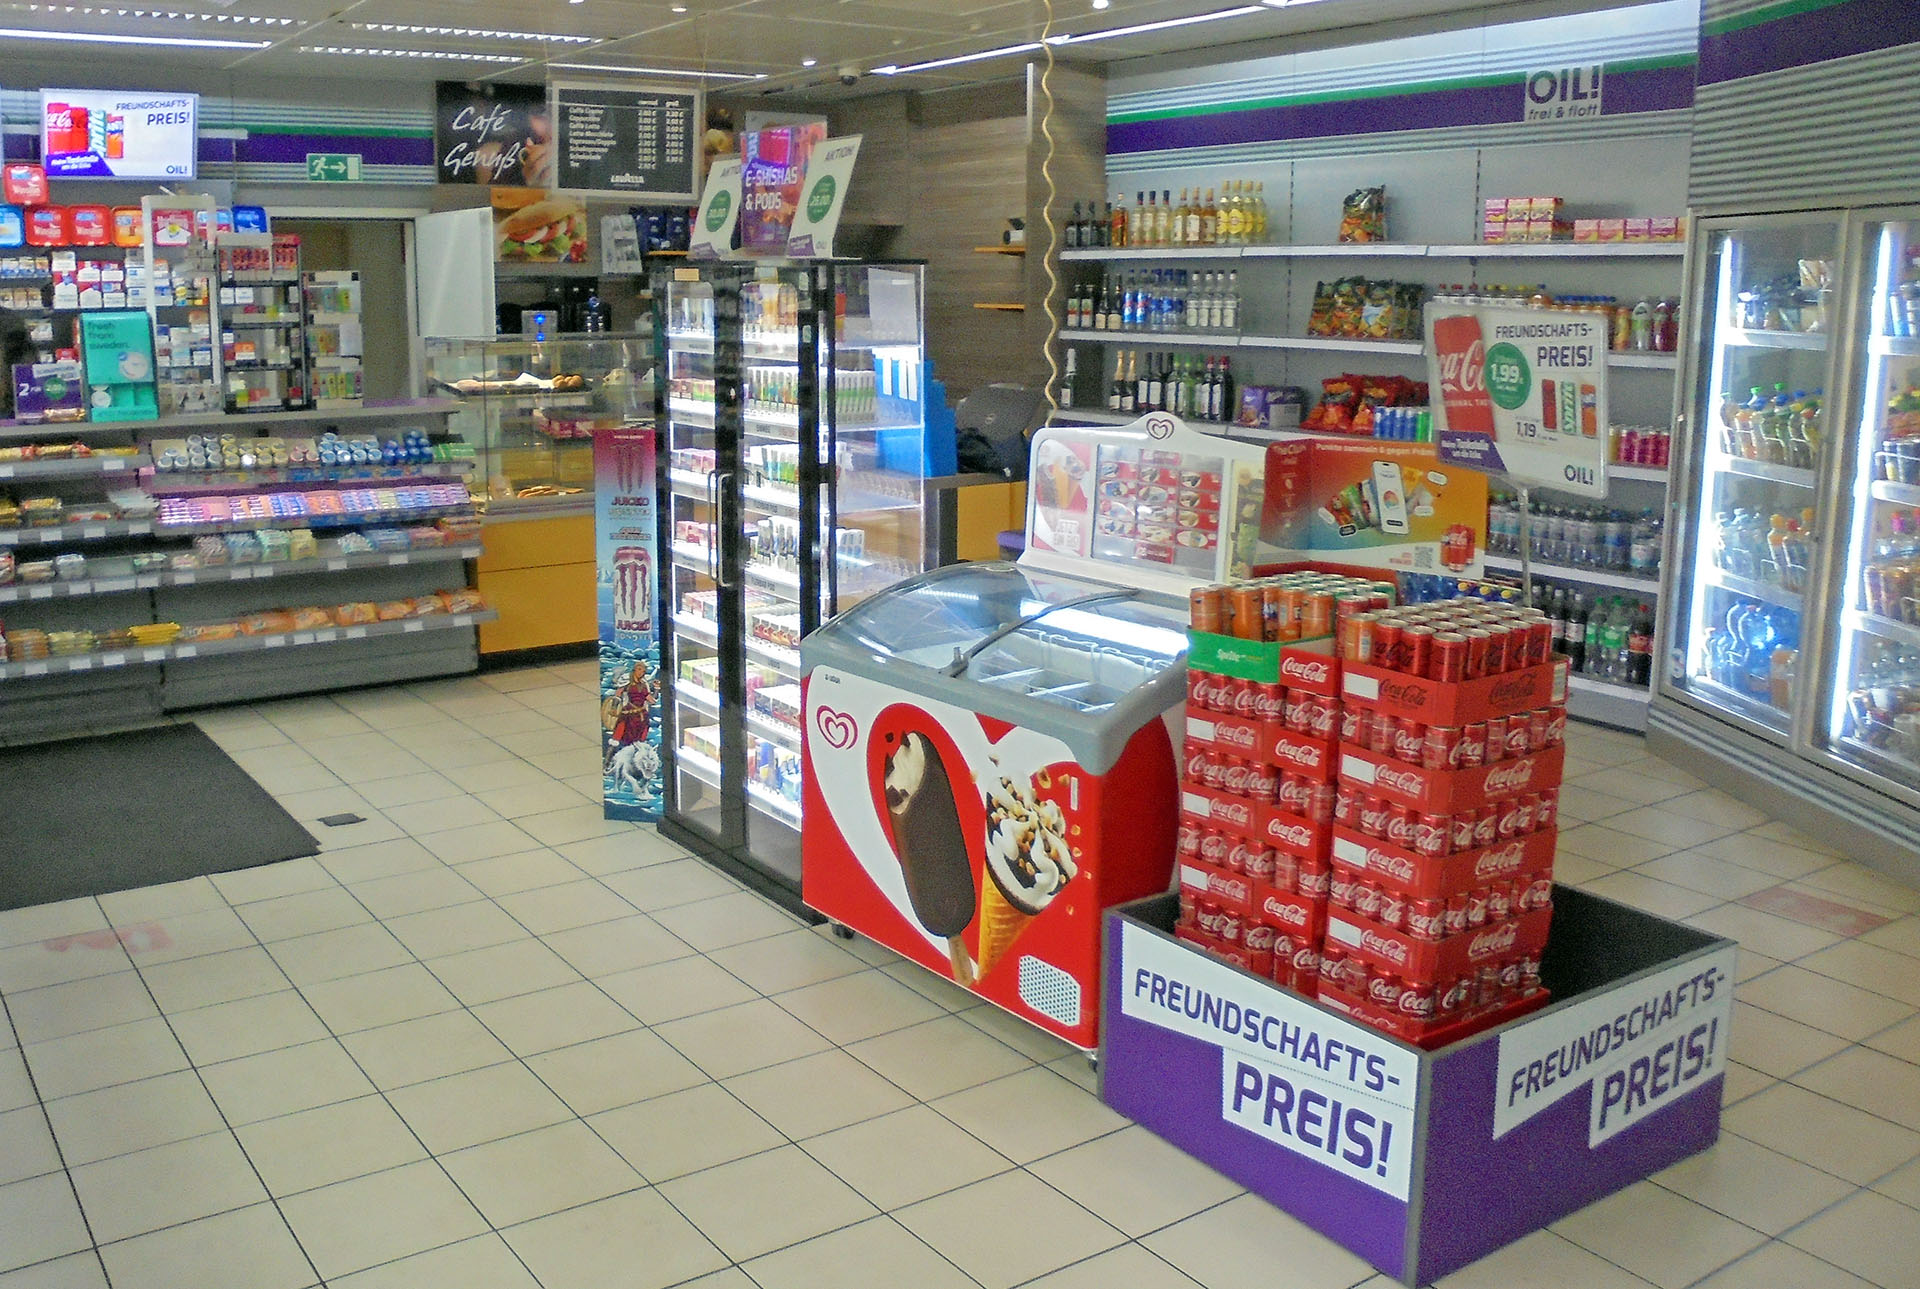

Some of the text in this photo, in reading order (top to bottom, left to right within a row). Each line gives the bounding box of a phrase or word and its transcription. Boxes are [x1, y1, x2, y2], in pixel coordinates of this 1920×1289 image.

[1528, 65, 1600, 104] OIL!
[116, 100, 190, 111] FREUNDSCHAFTS-
[1528, 104, 1597, 120] frei & flott
[147, 112, 190, 126] PREIS!
[452, 103, 513, 143] Café
[443, 142, 521, 180] Genuß
[824, 146, 857, 162] AKTION
[166, 165, 188, 174] OIL!
[745, 166, 799, 187] E-SHISHAS
[745, 191, 783, 211] & PODS
[1495, 323, 1593, 339] FREUNDSCHAFTS-
[1537, 345, 1594, 367] PREIS!
[18, 383, 30, 397] 2
[1516, 421, 1537, 437] 1,19
[1564, 464, 1594, 486] OIL!
[1281, 656, 1329, 683] Coca-Cola
[1275, 738, 1321, 767] Coca-Cola
[1267, 818, 1313, 847] Coca-Cola
[1263, 896, 1309, 926] Coca-Cola
[1135, 968, 1401, 1093] FREUNDSCHAFTS-
[1508, 967, 1725, 1107] FREUNDSCHAFTS-
[1599, 1016, 1718, 1130] PREIS!
[1232, 1060, 1393, 1178] PREIS!
